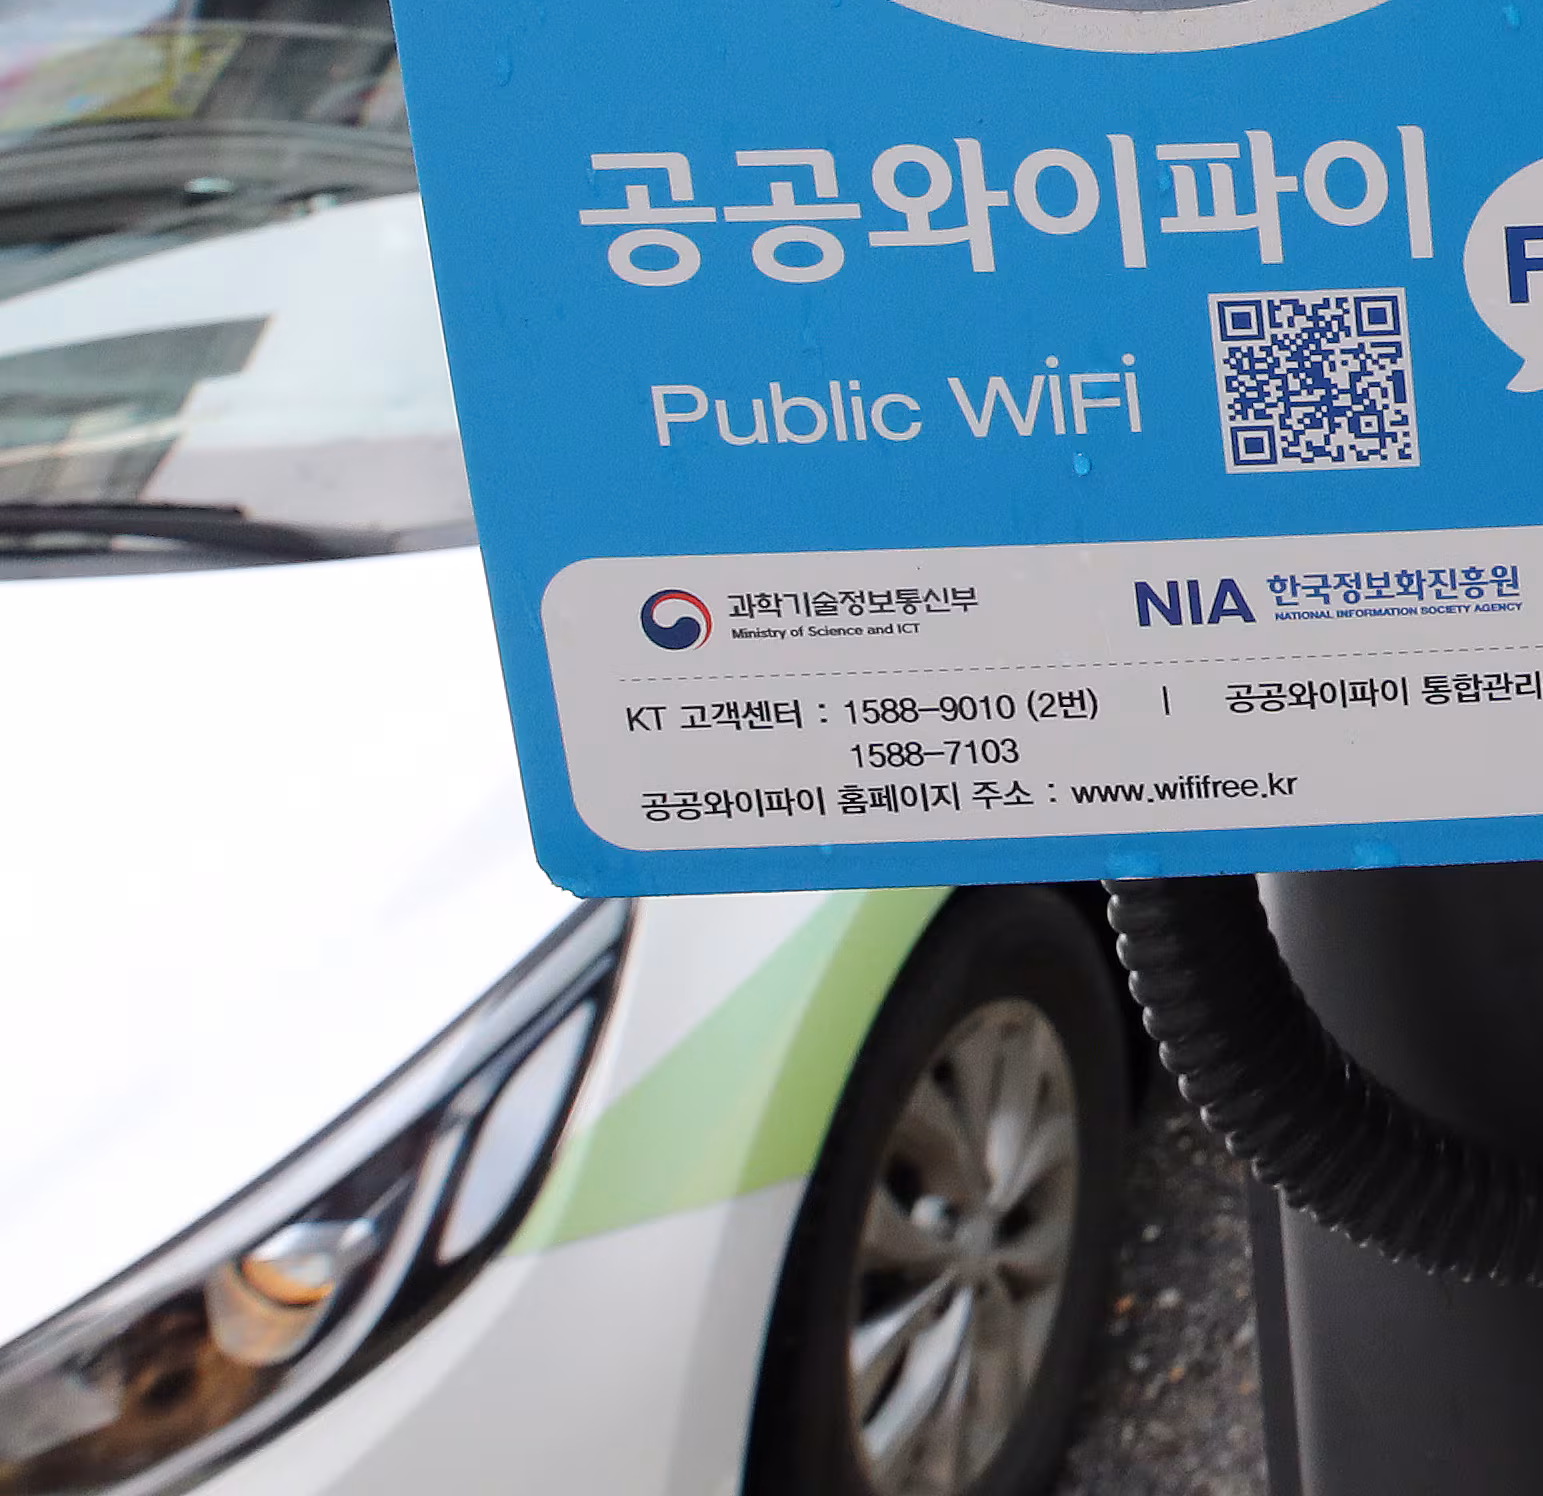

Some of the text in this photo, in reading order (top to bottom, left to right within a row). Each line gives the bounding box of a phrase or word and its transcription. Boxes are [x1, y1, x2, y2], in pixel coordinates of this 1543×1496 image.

[579, 126, 1434, 287] 공공와이파이
[651, 354, 1142, 446] Public WiFi
[727, 587, 978, 619] 과학기술정보통신부
[1134, 578, 1256, 627] NIA
[1266, 565, 1520, 606] 한국정보화진흥원
[732, 623, 920, 640] Ministry of Science and ICT
[1275, 602, 1522, 621] NATIONAL INFORMATION SOCIETY AGENCY
[626, 706, 667, 731] KT
[680, 699, 802, 730] 고객센터
[844, 695, 1015, 724] 1588-9010
[1027, 688, 1098, 722] (2번)
[1225, 677, 1409, 713] 공공와이파이
[850, 738, 1019, 768] 1588-7103
[641, 786, 826, 821] 공공와이파이
[837, 782, 960, 814] 홈페이지
[972, 780, 1034, 809] 주소
[1070, 773, 1298, 803] www.wififree.kr
